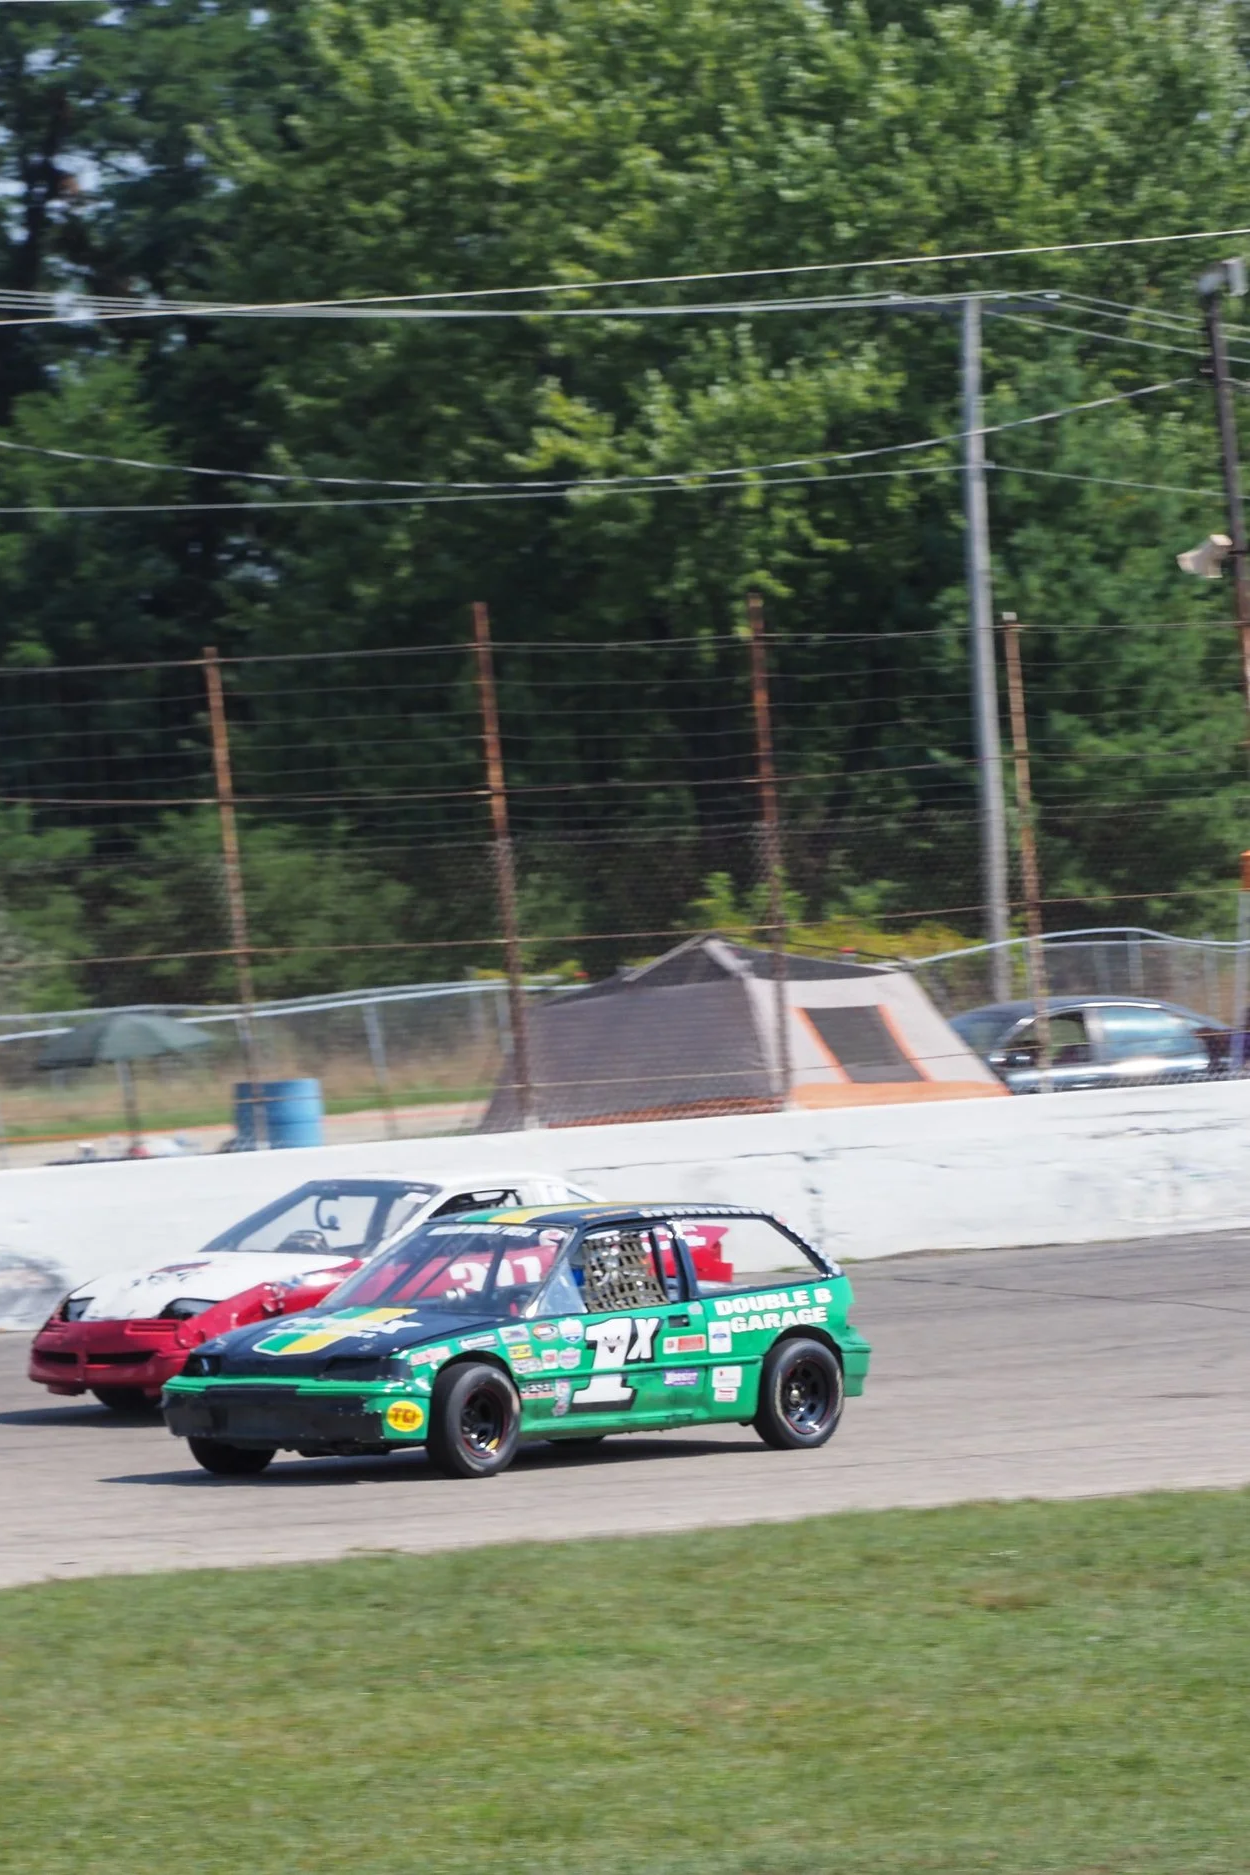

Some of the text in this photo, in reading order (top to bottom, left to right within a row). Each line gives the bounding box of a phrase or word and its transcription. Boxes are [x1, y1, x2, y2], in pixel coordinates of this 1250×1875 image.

[714, 1287, 833, 1317] DOUBLE B
[730, 1306, 829, 1334] GARAGE
